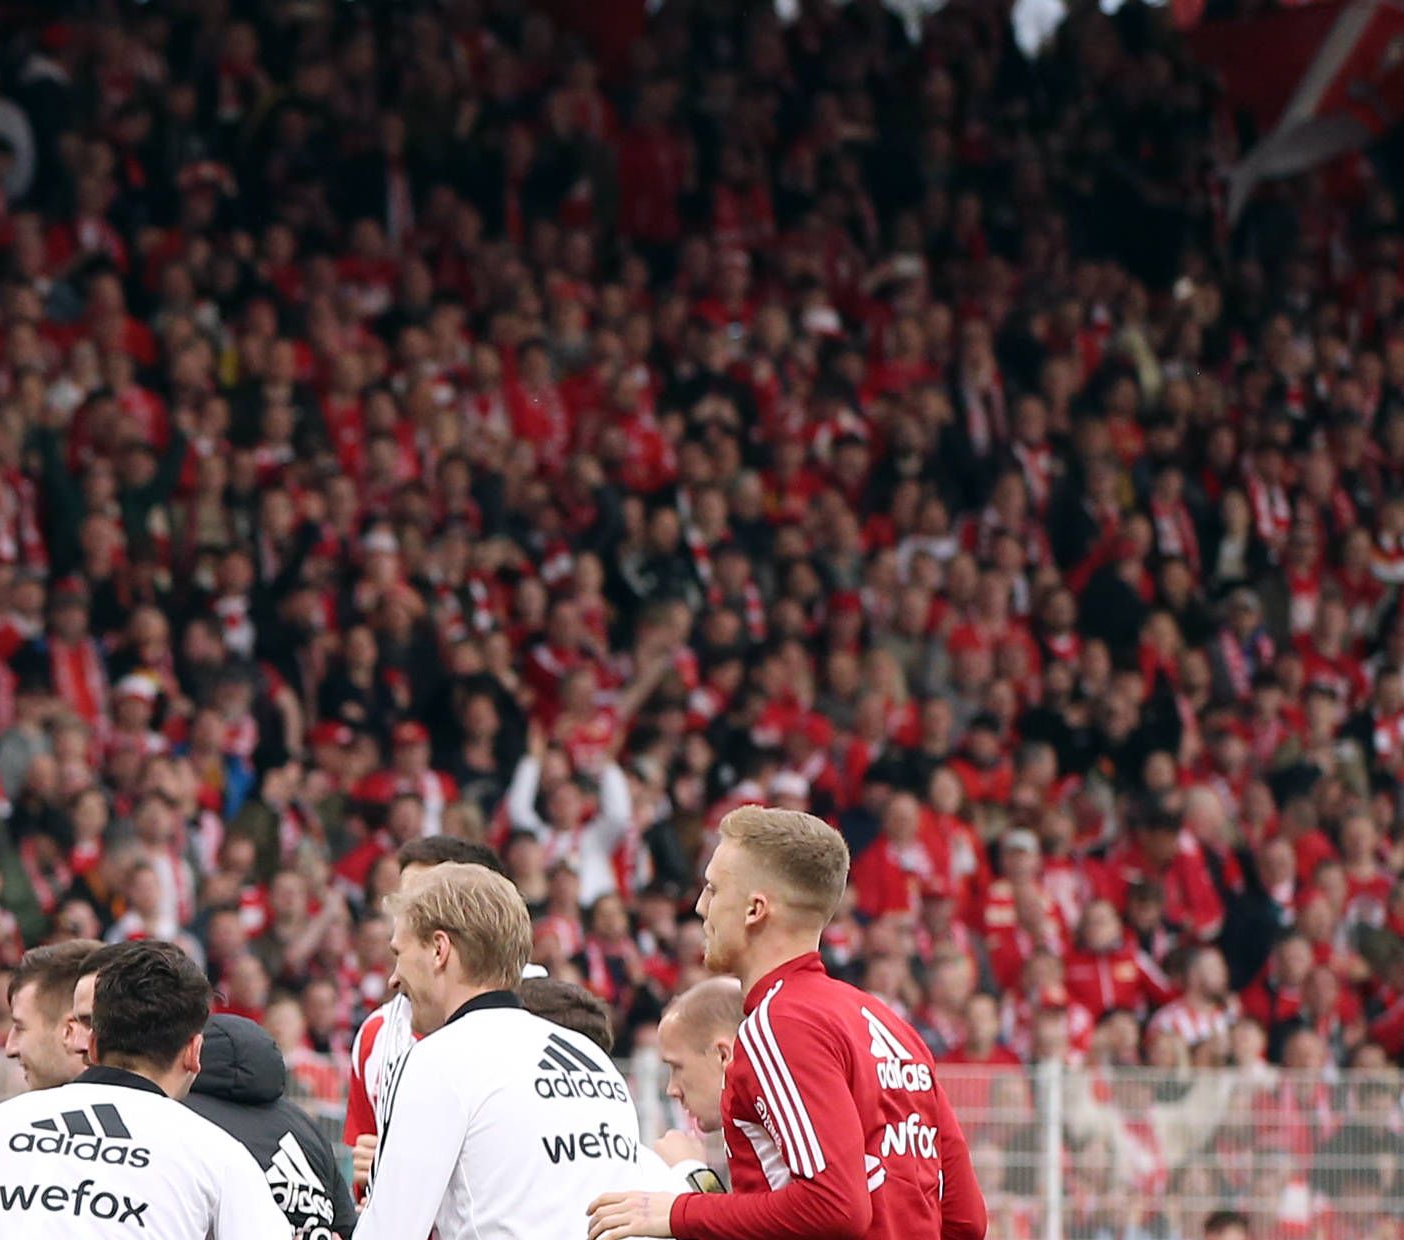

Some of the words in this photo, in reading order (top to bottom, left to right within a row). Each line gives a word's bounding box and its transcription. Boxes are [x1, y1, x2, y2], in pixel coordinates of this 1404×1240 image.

[534, 1071, 628, 1103] adidas
[8, 1132, 152, 1169] adidas
[272, 1180, 335, 1225] didas
